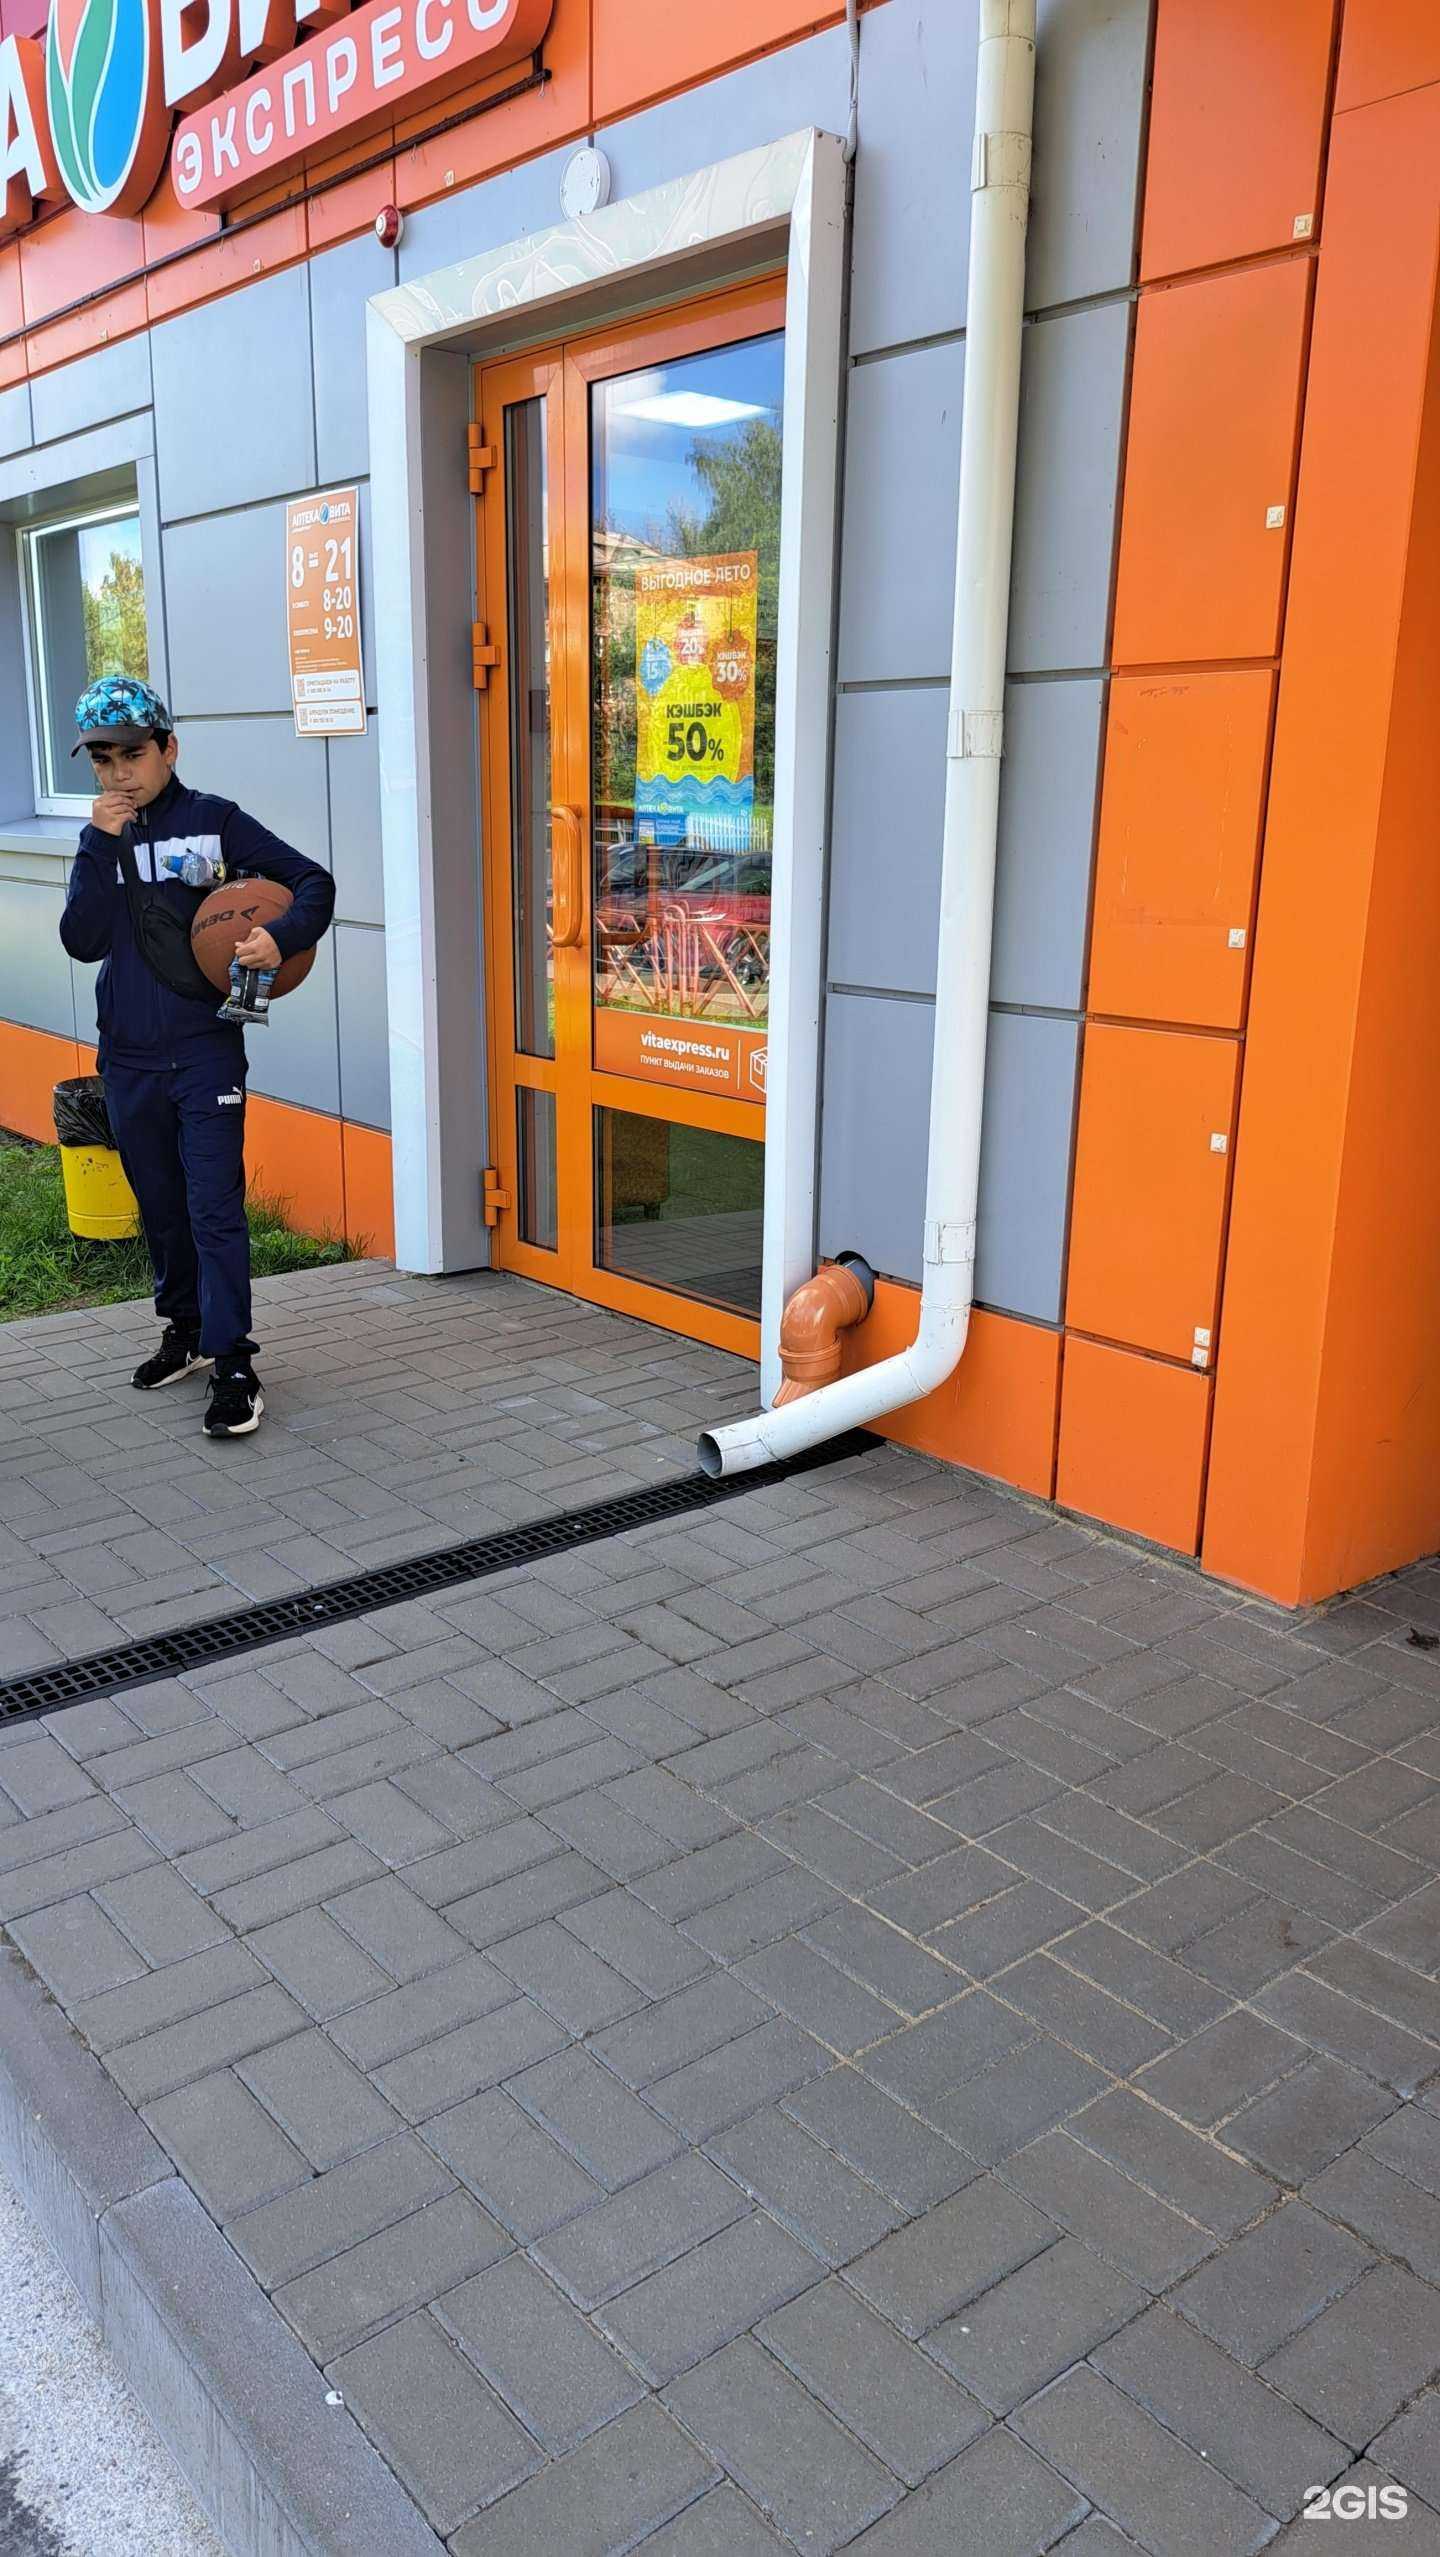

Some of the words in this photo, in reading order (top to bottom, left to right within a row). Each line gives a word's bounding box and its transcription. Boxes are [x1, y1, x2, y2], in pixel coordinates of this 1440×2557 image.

[292, 507, 320, 528] АПТЕКА
[330, 502, 351, 519] ВИТА
[292, 545, 304, 588] 8
[325, 536, 351, 582] 21
[641, 568, 711, 591] ВЫГОДНОЕ
[715, 564, 750, 583] ЛЕТО
[323, 586, 352, 612] 8-20
[324, 614, 353, 640] 9-20
[717, 661, 747, 682] 30%
[666, 703, 722, 718] КЭШБЭК
[667, 722, 725, 761] 50%
[641, 1030, 730, 1060] vitaexpress.ru
[640, 1054, 663, 1065] ПУНКТ
[664, 1059, 694, 1073] ВЫДАЧИ
[695, 1065, 730, 1079] ЗАКАЗОВ
